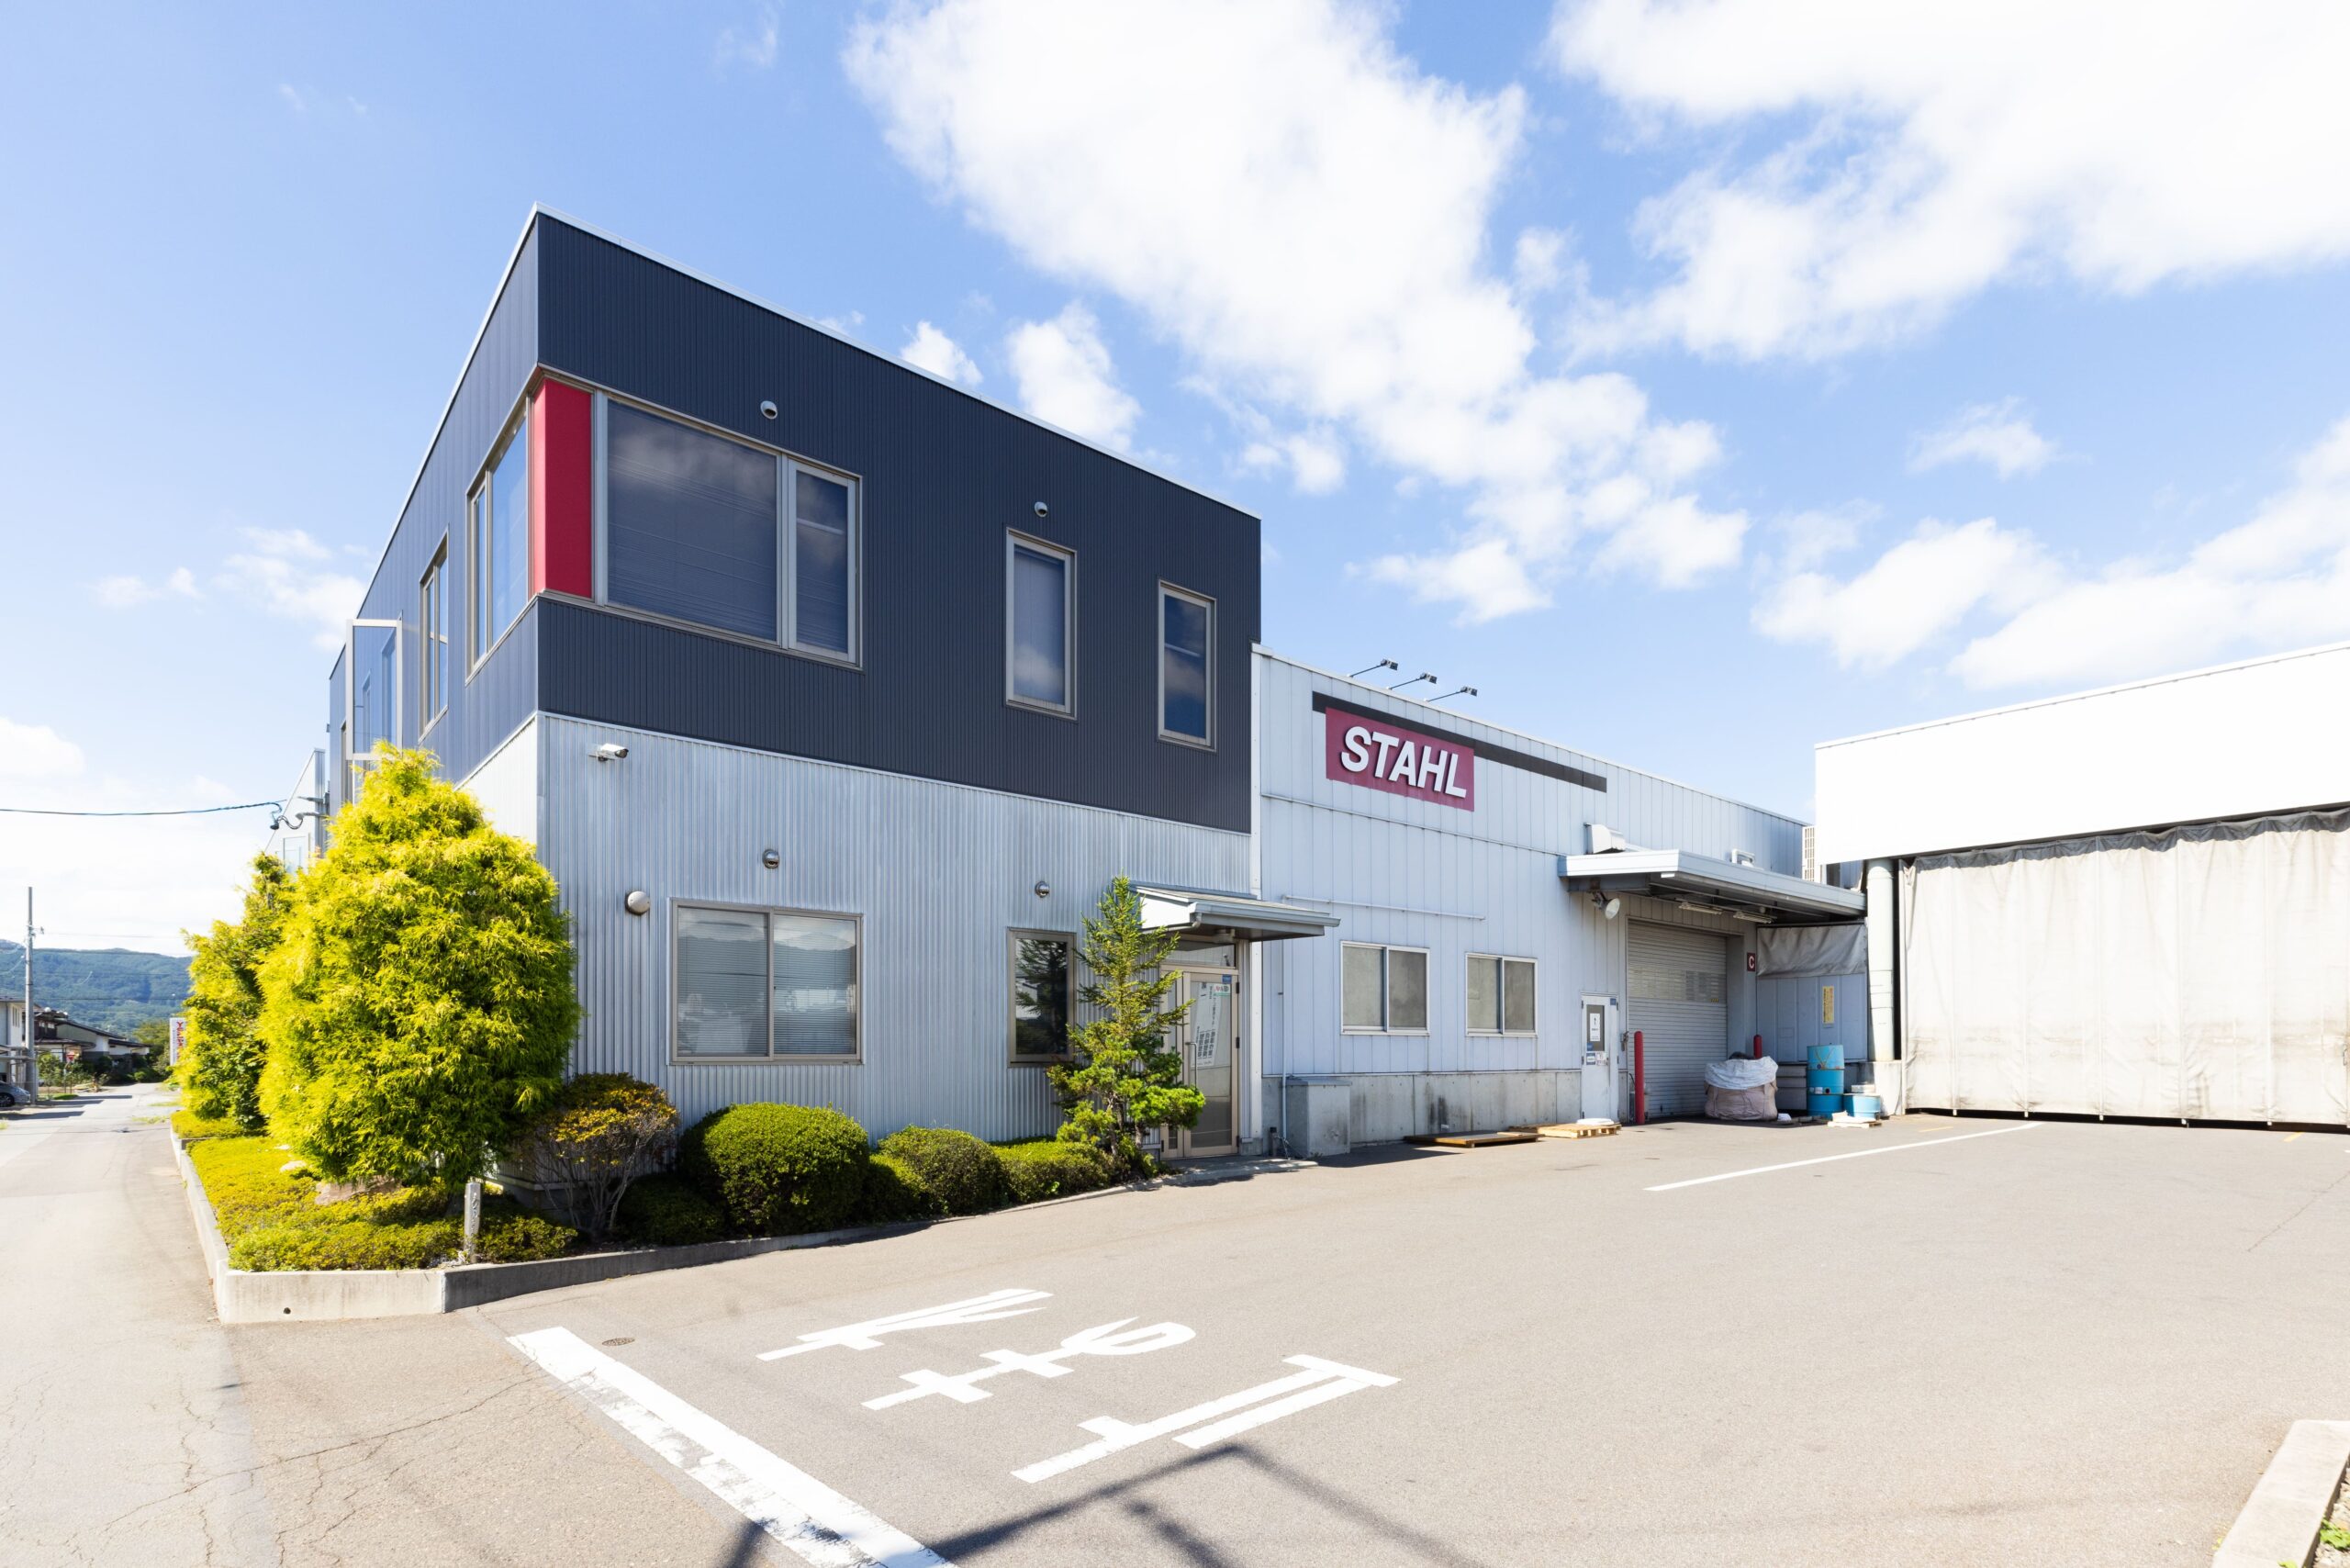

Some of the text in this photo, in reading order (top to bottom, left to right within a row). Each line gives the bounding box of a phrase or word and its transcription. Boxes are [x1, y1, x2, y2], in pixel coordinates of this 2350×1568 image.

[1341, 726, 1467, 799] STAHL
[1749, 956, 1754, 969] C
[755, 1288, 1401, 1484] 止まれ
